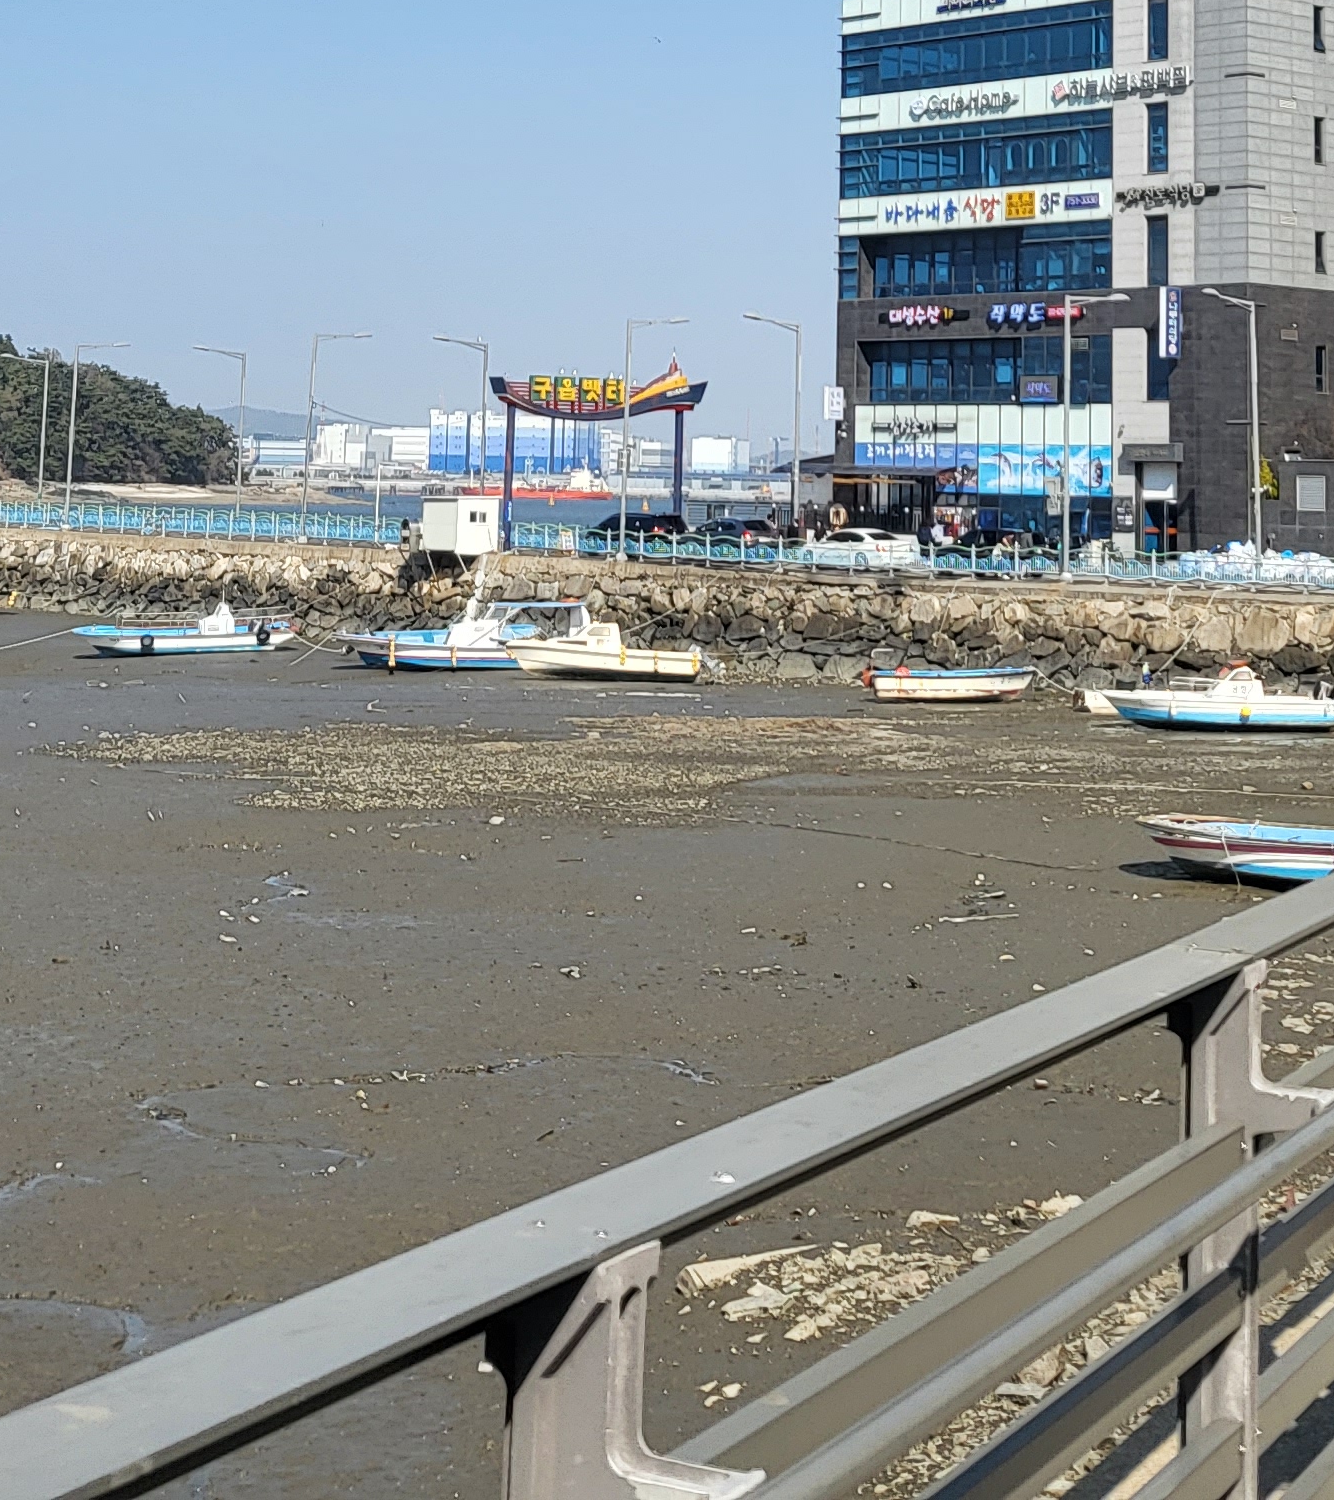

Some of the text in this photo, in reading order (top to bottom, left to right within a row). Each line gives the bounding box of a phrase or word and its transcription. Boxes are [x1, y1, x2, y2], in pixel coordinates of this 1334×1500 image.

[927, 88, 1012, 111] Cafe Home
[963, 193, 1001, 223] 식당
[1039, 191, 1061, 215] 3F
[888, 304, 941, 326] 대성수산
[989, 302, 1046, 324] 작약도
